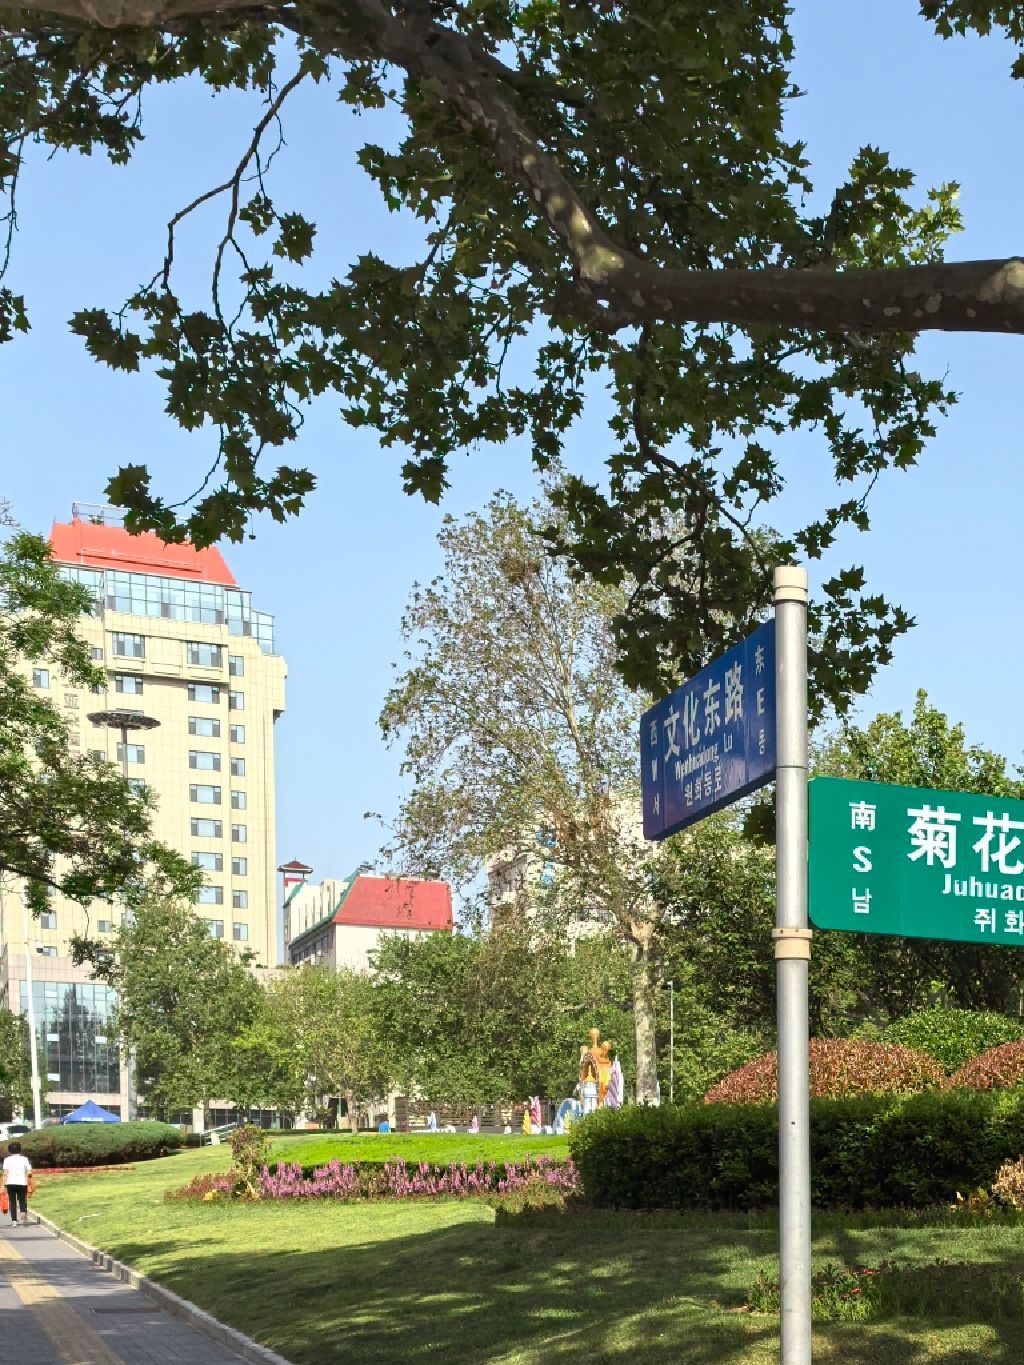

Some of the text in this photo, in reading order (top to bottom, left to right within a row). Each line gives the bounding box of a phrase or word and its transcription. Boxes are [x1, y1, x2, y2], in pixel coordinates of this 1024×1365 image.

[663, 660, 744, 762] 文化东路
[756, 687, 765, 717] E
[723, 731, 734, 753] Lu
[651, 757, 658, 782] W
[848, 800, 877, 831] 南
[852, 846, 873, 873] S
[852, 888, 873, 914] 남
